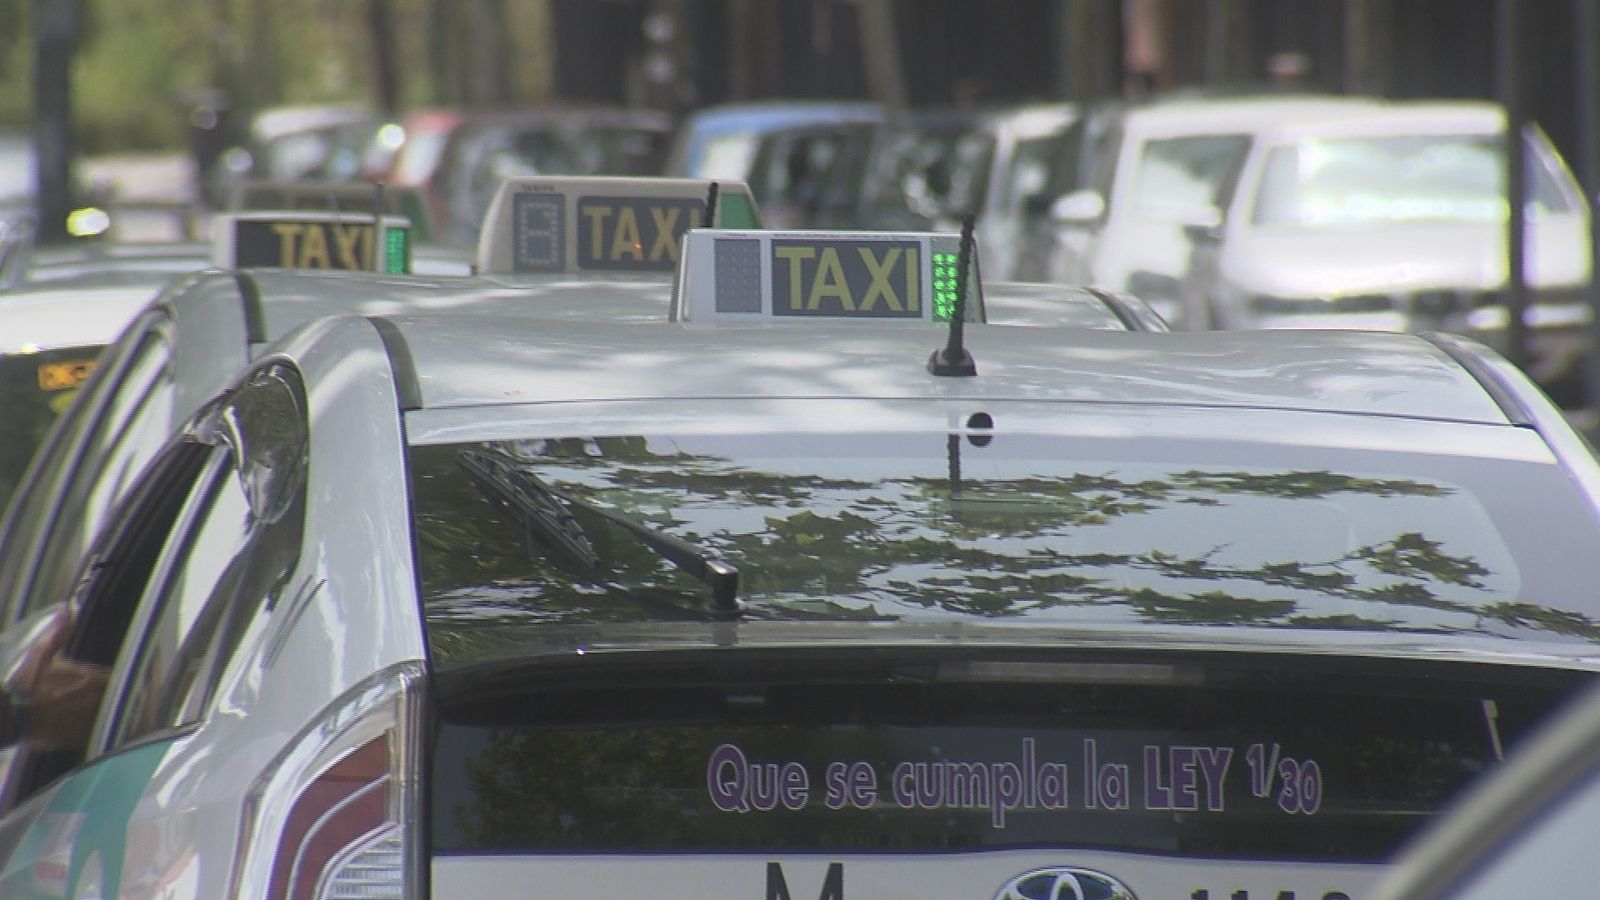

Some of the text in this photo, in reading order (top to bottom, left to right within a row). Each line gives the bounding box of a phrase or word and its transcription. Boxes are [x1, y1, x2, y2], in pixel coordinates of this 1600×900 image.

[272, 223, 376, 270] TAXI
[774, 245, 920, 312] TAXI
[707, 738, 1323, 829] Que se cumpla la LEY 1/30
